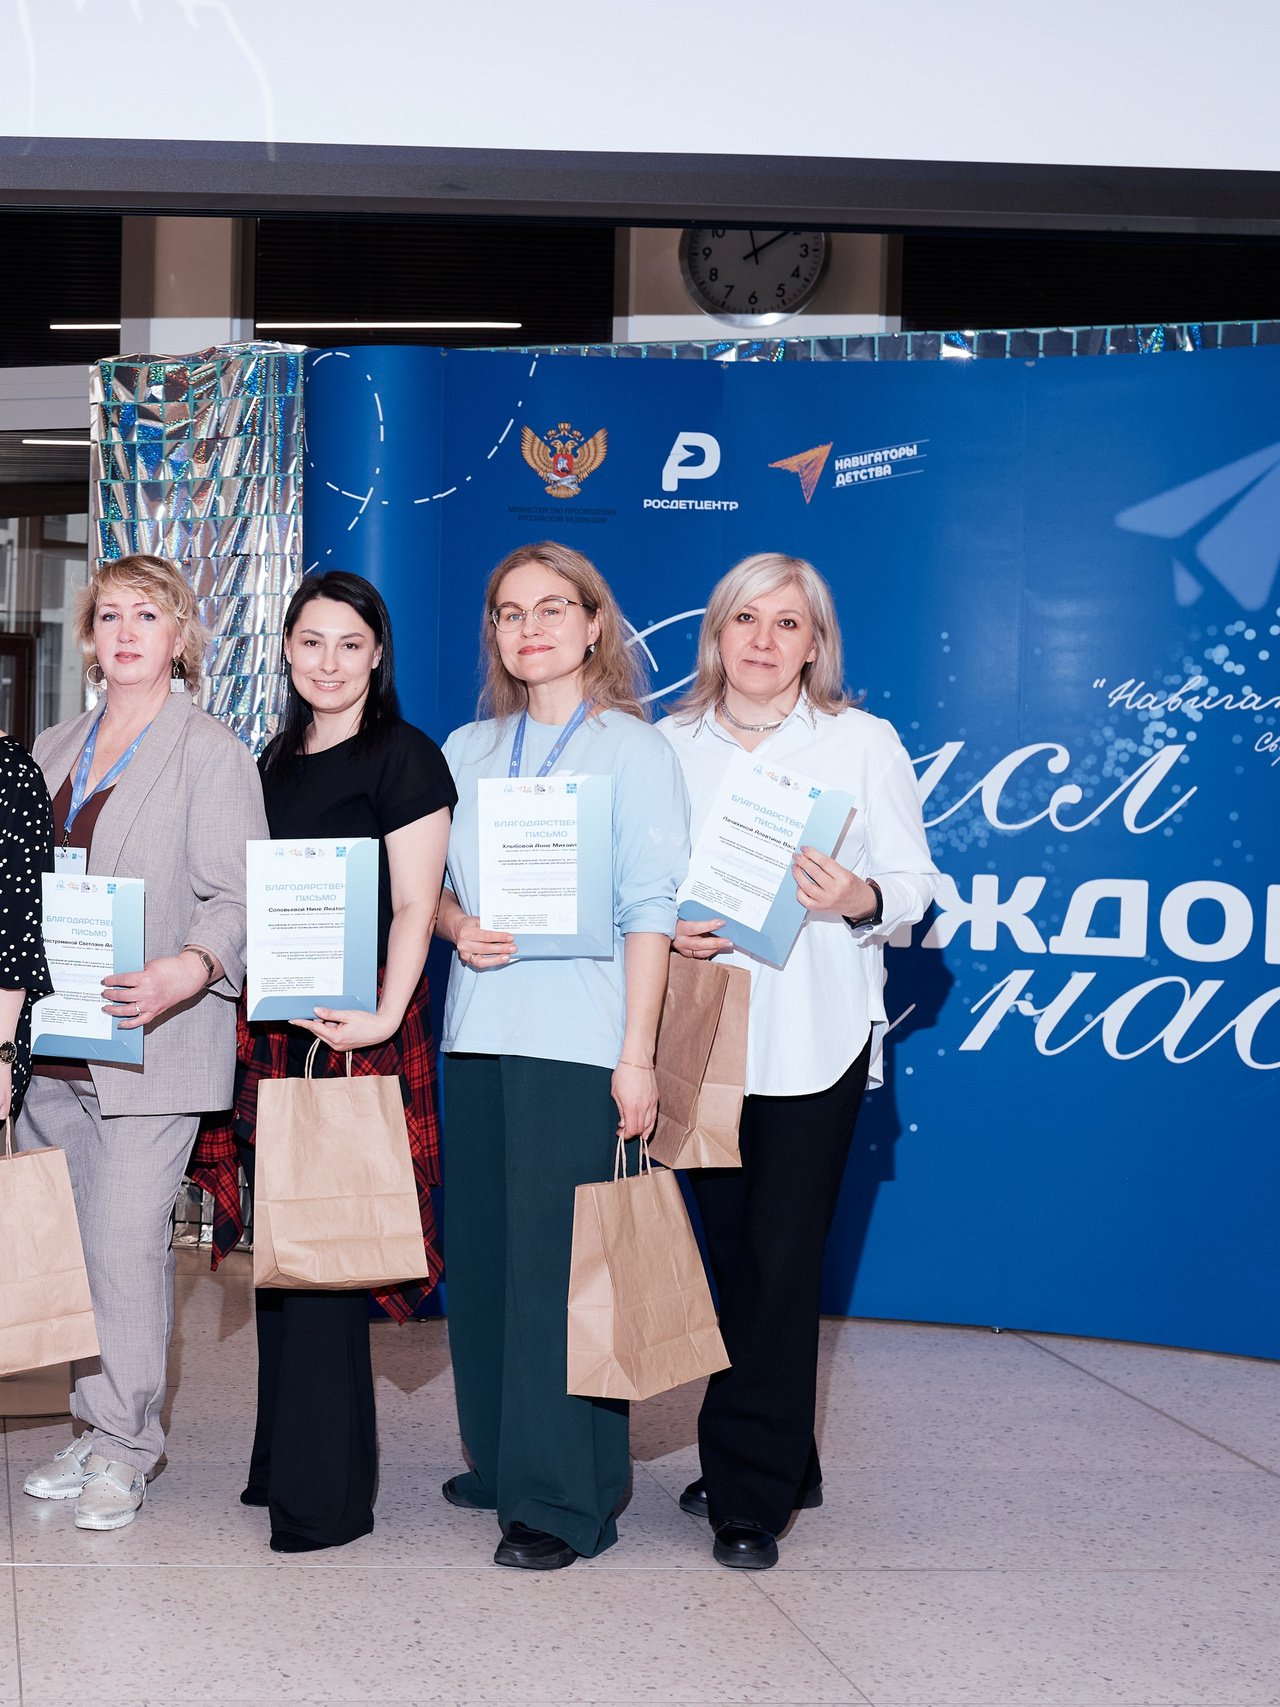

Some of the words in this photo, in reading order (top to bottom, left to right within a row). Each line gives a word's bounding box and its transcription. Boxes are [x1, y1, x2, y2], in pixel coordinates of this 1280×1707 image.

[702, 246, 712, 260] 9
[799, 244, 809, 258] 3
[709, 268, 718, 282] 8
[790, 266, 800, 279] 4
[724, 285, 734, 299] 7
[748, 291, 758, 305] 6
[776, 284, 786, 298] 5
[834, 444, 918, 471] НАВИГАТОРЫ
[836, 464, 892, 488] ДЕТСТВА
[643, 498, 739, 511] РОСДЕТЦЕНТР
[494, 820, 578, 828] БЛАГОДАРСТВЕН
[754, 816, 794, 838] ПИСЬМО
[266, 883, 346, 891] БЛАГОДАРСТВЕН
[46, 915, 113, 926] БЛАГОДАРСТВЕ
[888, 873, 1280, 965] ЖДО
[72, 928, 108, 938] ПИСЬМО
